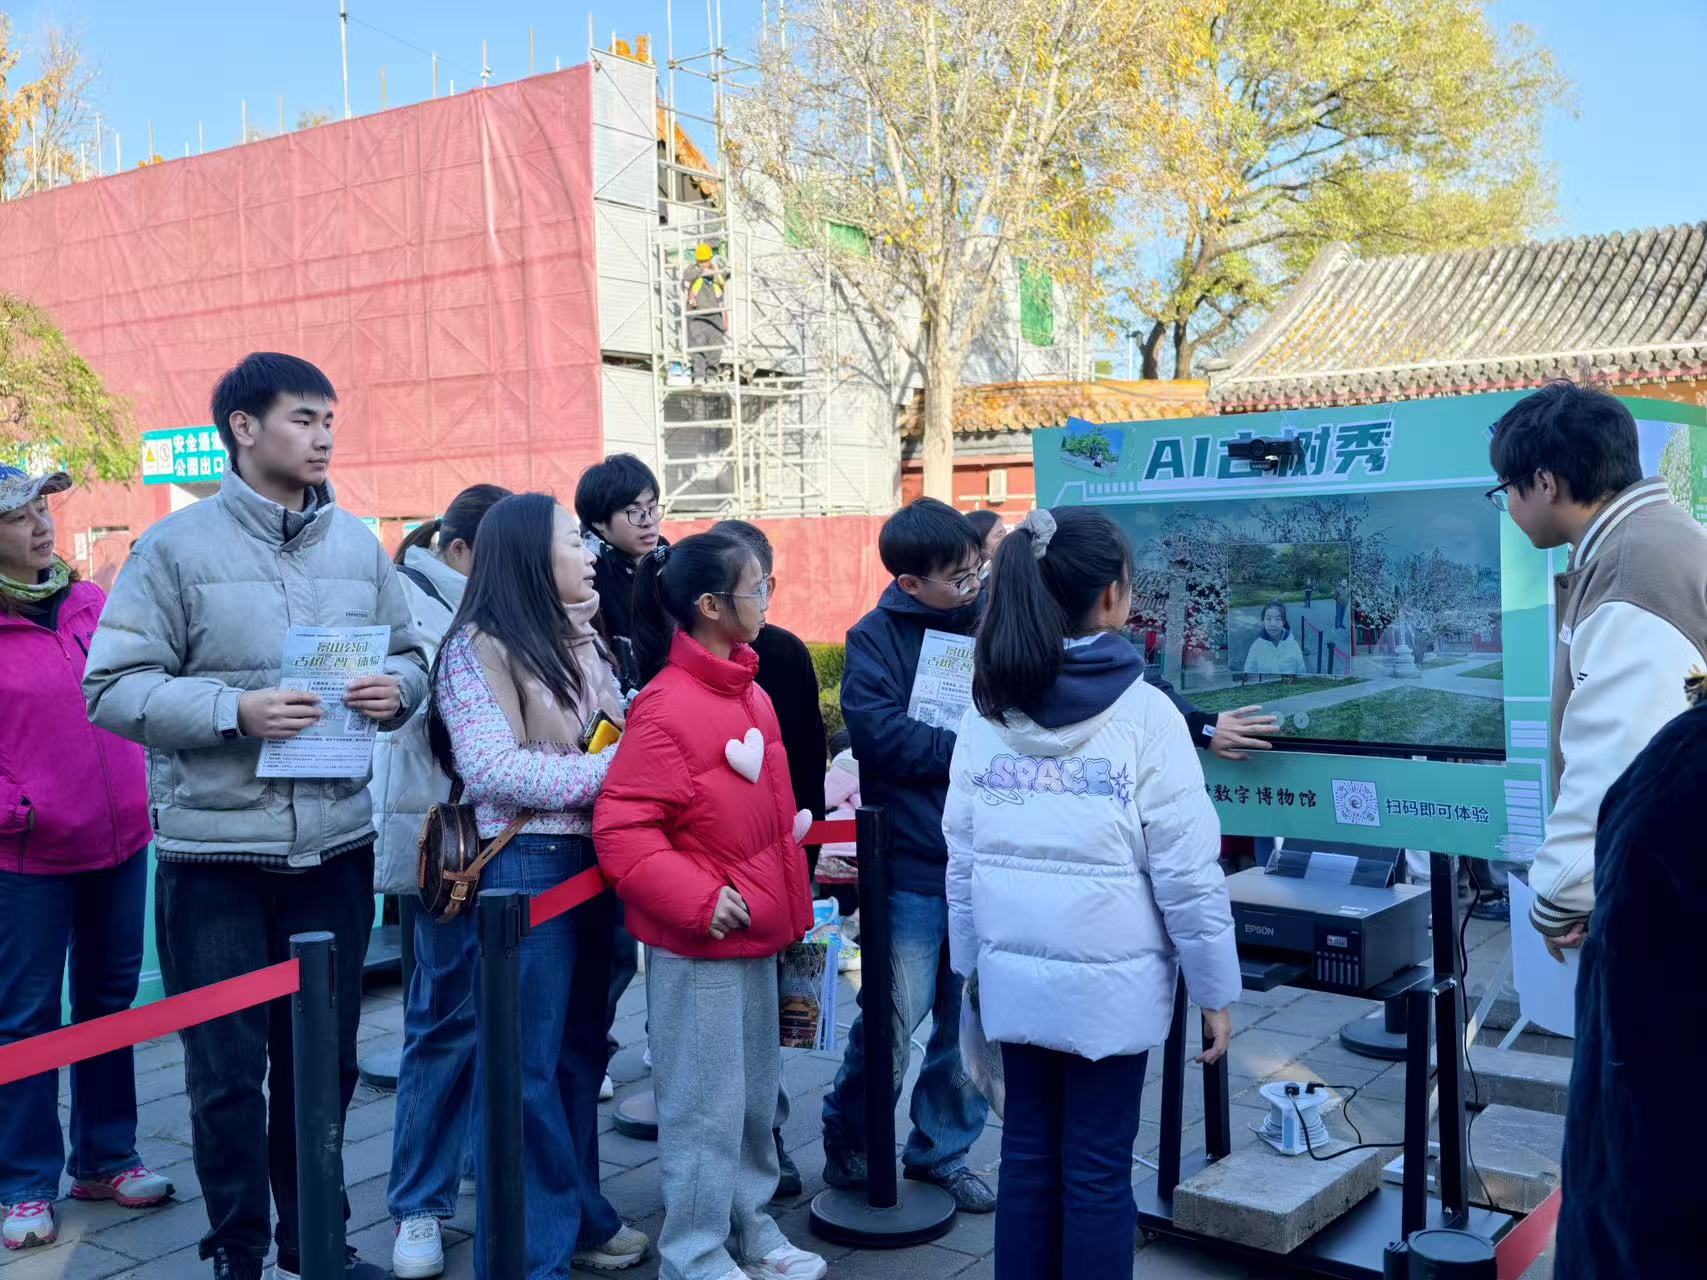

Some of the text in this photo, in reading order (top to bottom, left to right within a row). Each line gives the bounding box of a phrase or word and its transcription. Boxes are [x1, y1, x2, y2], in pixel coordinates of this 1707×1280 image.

[987, 753, 1113, 796] SPACE
[1205, 783, 1317, 808] 数字博物馆
[1385, 797, 1490, 824] 扫码即可体验
[1244, 923, 1275, 937] EPSON
